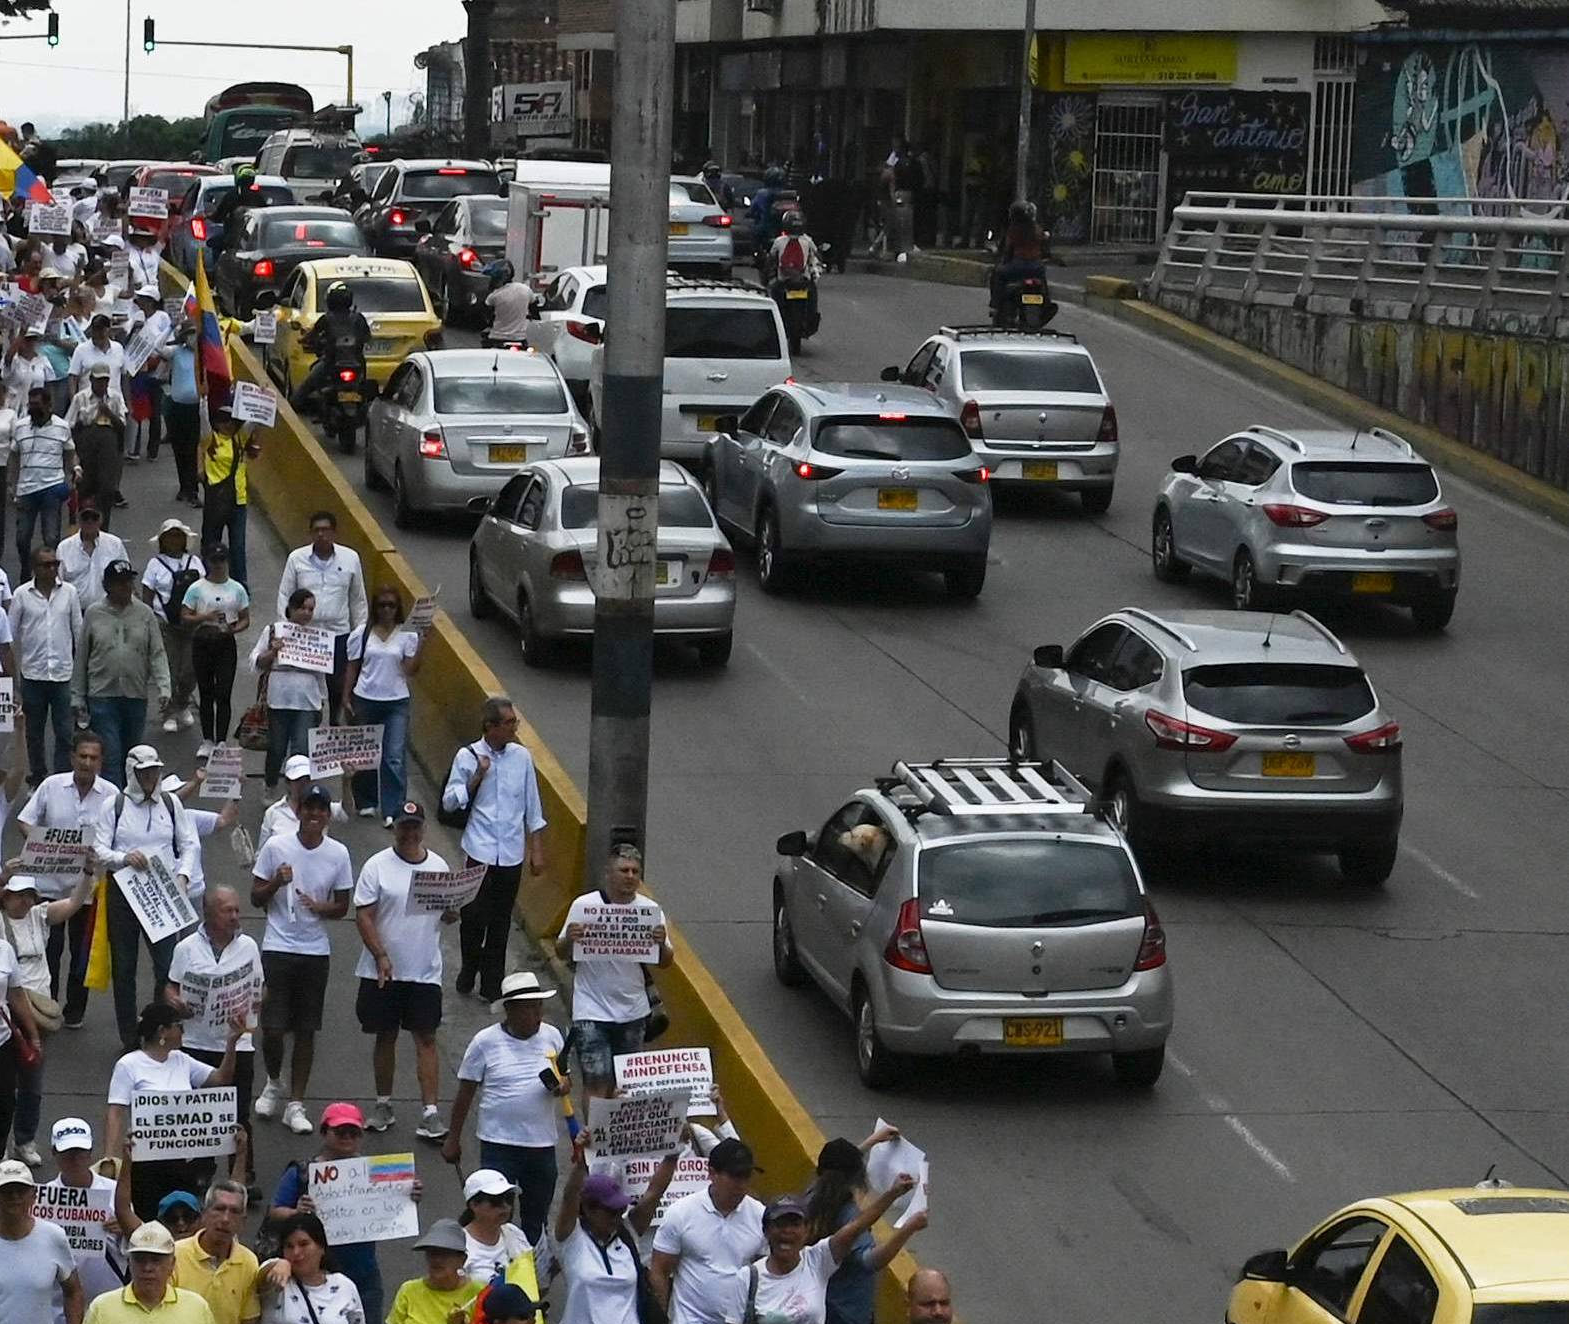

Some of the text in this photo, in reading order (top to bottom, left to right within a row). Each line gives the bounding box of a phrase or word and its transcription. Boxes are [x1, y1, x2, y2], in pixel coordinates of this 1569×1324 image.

[600, 907, 638, 915] ELIMINA
[627, 1052, 701, 1067] #RENUNCIE
[623, 1063, 706, 1079] MINDEFENSA
[655, 1078, 691, 1087] DEFENSA
[135, 1092, 234, 1108] ¡DIOS Y PATRIA!
[621, 1100, 648, 1110] PONE
[609, 1102, 674, 1119] TRAFICANTE
[648, 1111, 670, 1120] QUE
[136, 1111, 234, 1127] EL ESMAD SE
[57, 1127, 86, 1137] adidas
[134, 1126, 236, 1139] QUEDA CON SUS
[593, 1126, 607, 1134] AL
[595, 1126, 679, 1142] AL DELINCUENTE
[149, 1137, 221, 1150] FUNCIONES
[596, 1143, 677, 1158] AL EMPRESARIO
[314, 1165, 339, 1185] NO
[626, 1161, 650, 1175] #SIN
[57, 1207, 106, 1222] CUBANOS
